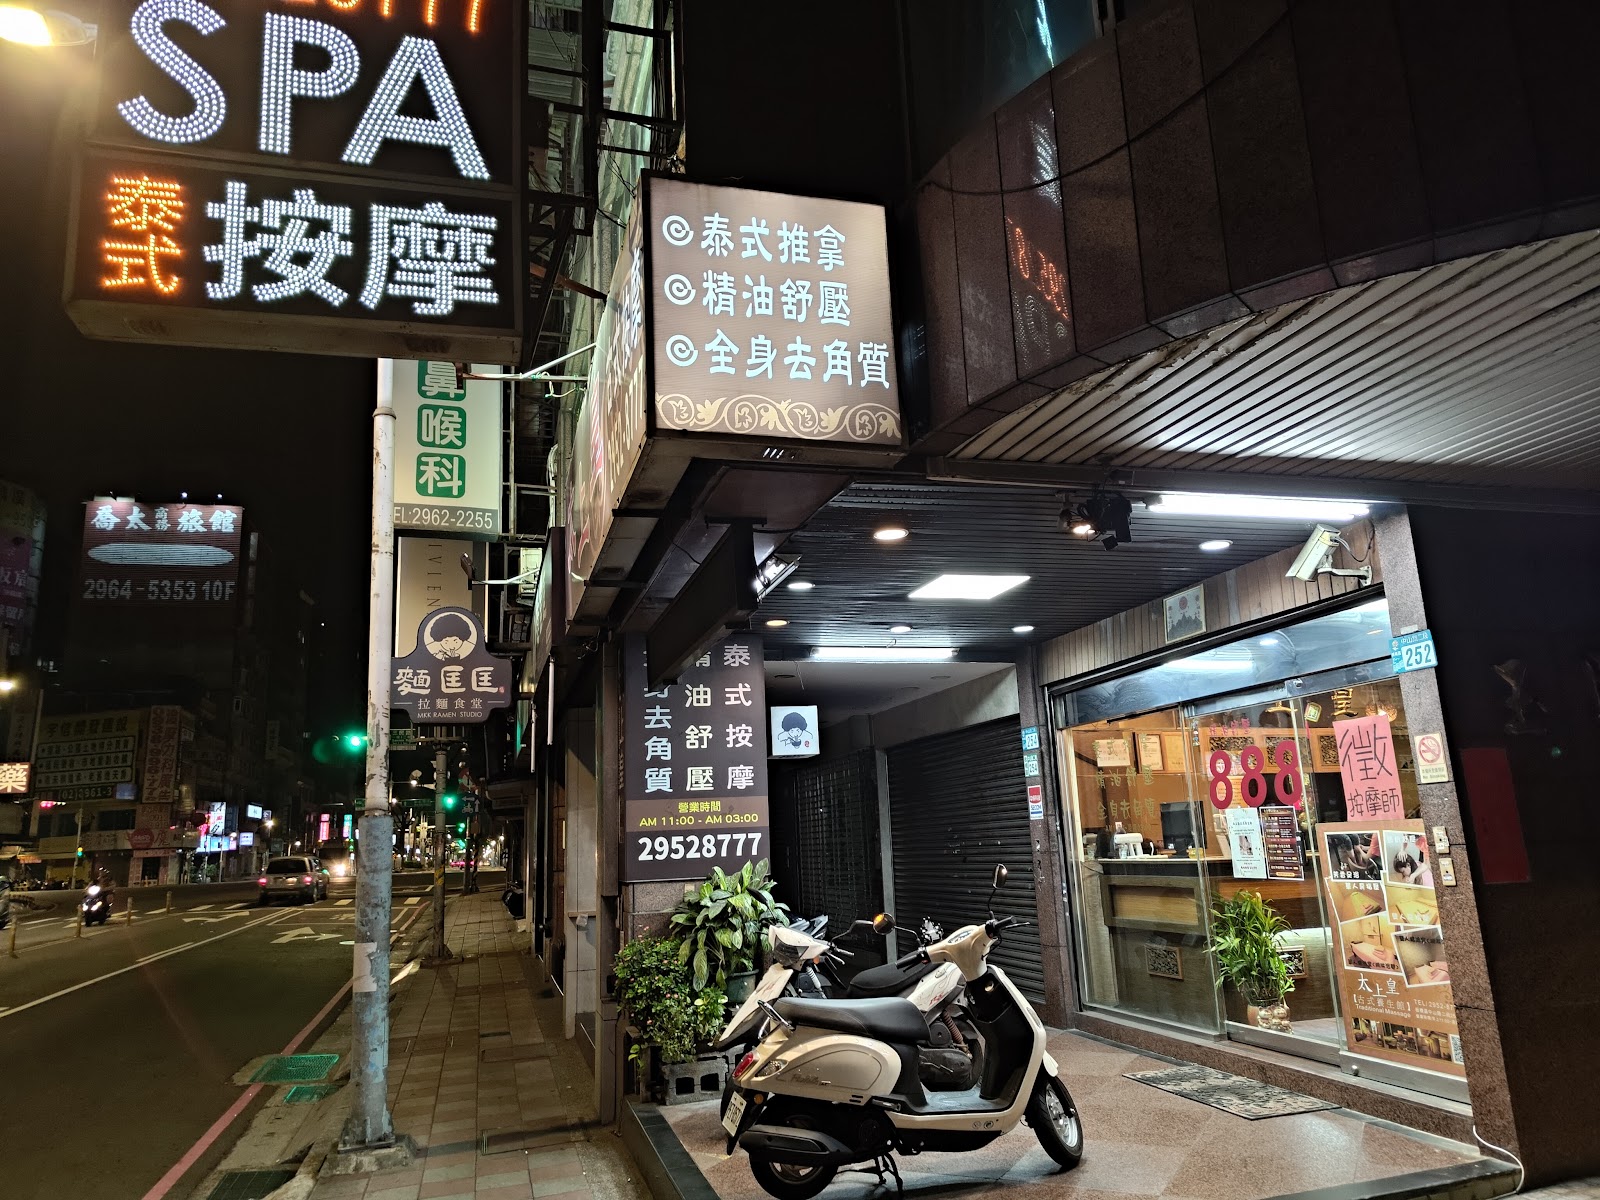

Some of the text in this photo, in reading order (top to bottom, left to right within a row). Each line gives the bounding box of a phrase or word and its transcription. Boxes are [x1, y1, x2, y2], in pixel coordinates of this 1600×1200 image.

[116, 0, 491, 180] SPA
[102, 176, 185, 294] 泰式
[203, 180, 499, 316] 按摩
[700, 212, 846, 271] 泰式推拿
[702, 269, 851, 326] 精油舒壓
[704, 328, 890, 389] 全身去角質
[394, 505, 493, 529] EL:2962-2255
[1405, 643, 1432, 667] 252
[643, 650, 673, 793] 去角質
[723, 644, 755, 790] 泰式按摩
[1209, 740, 1302, 810] 888
[1338, 723, 1393, 783] 徵
[639, 817, 657, 827] AM
[661, 815, 695, 826] 11:00
[705, 814, 722, 824] AM
[725, 813, 759, 824] 03:00
[678, 801, 721, 813] 營業時間
[1348, 786, 1400, 818] 按摩師
[638, 832, 762, 861] 29528777
[1357, 972, 1400, 998] 太上皇
